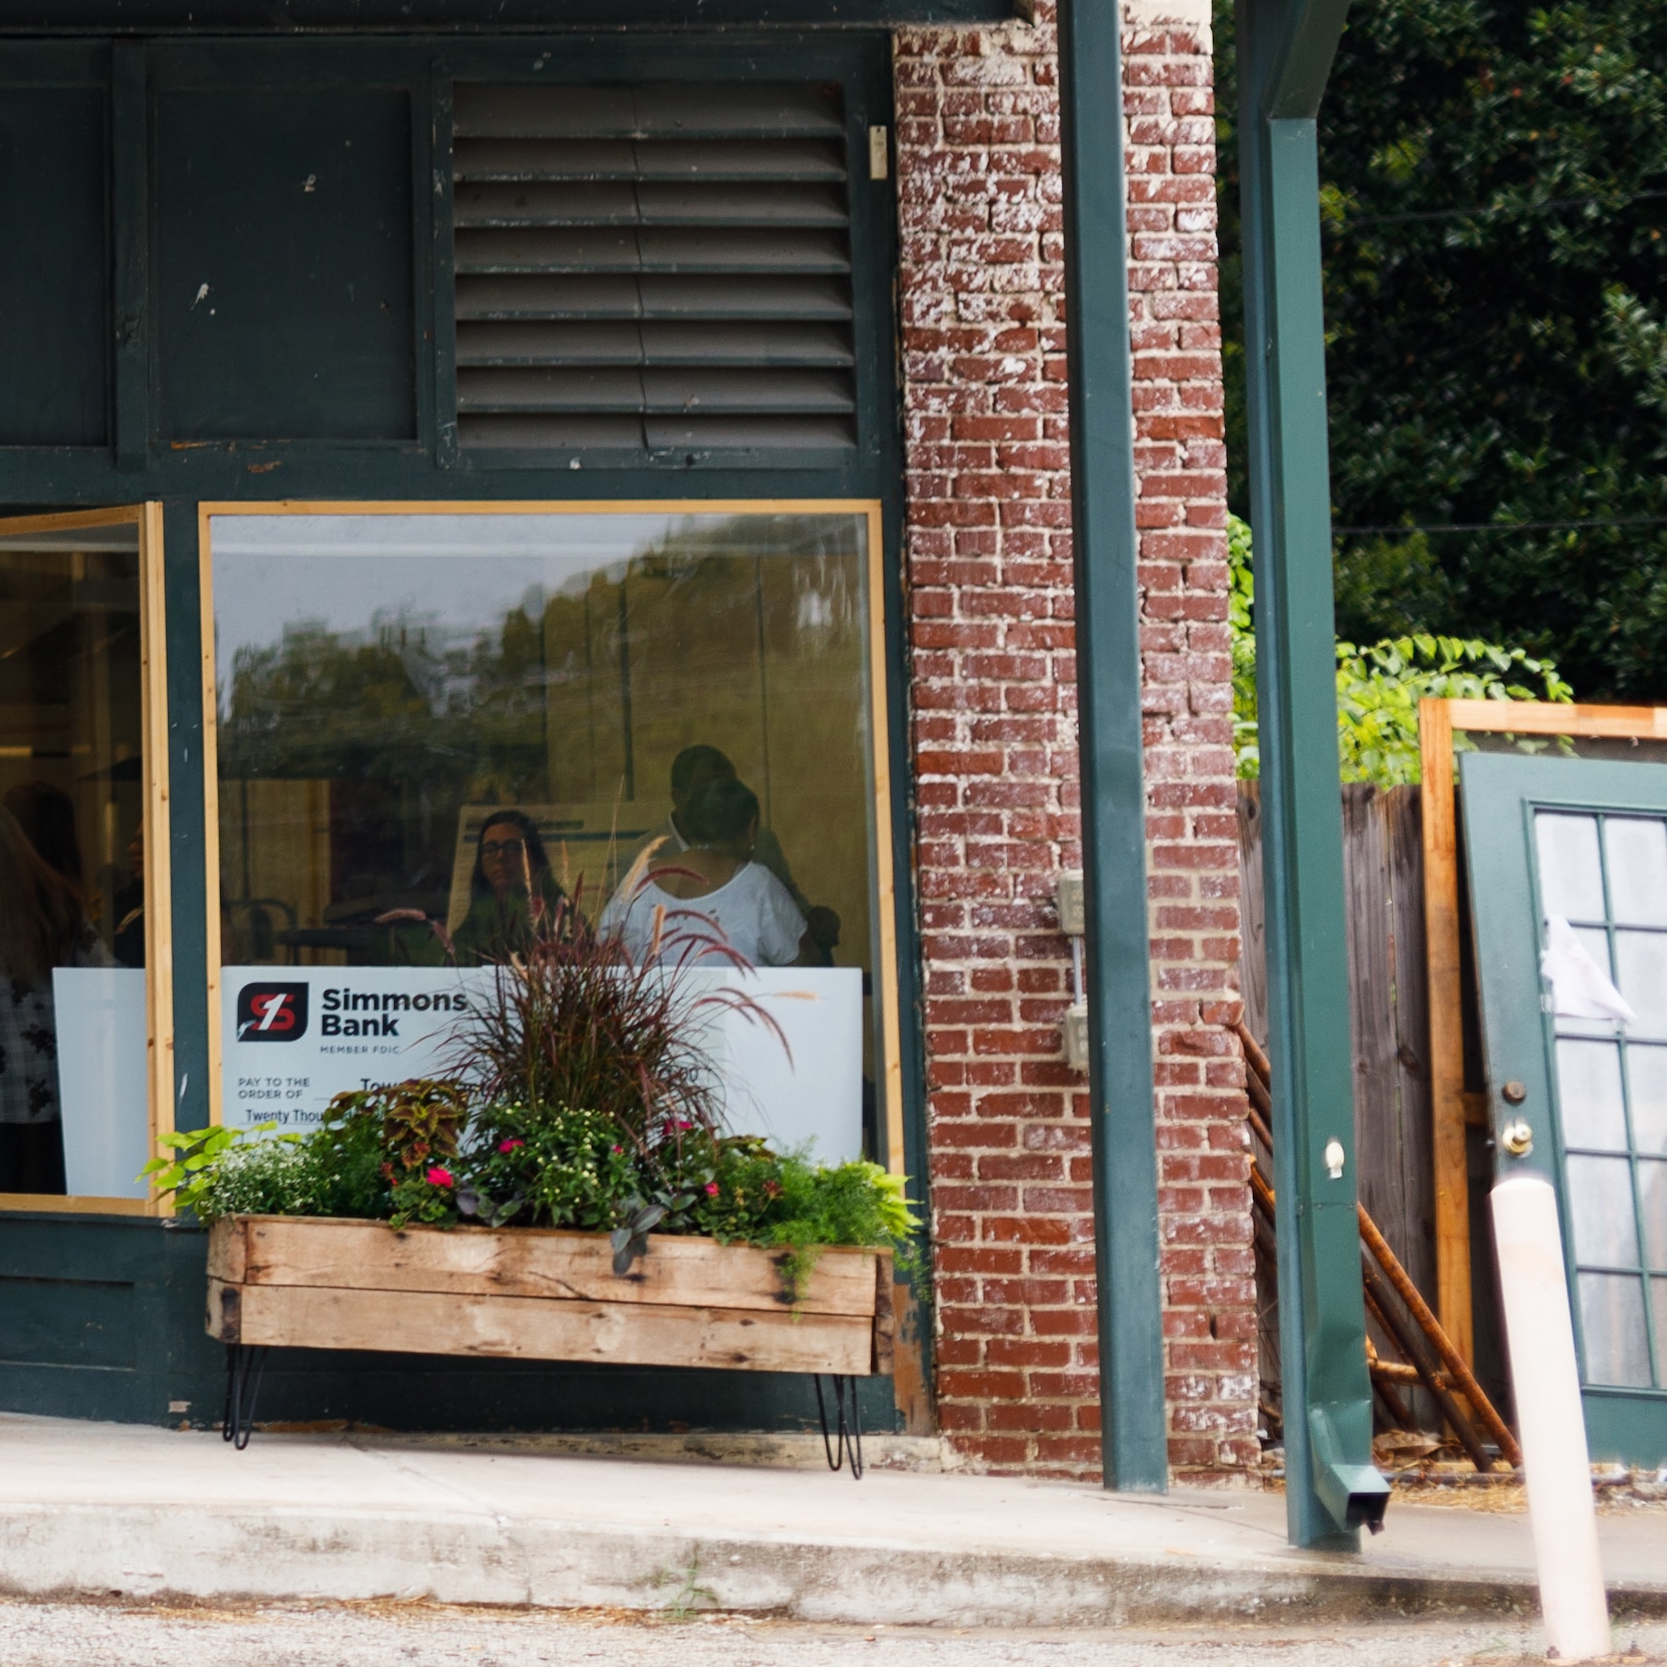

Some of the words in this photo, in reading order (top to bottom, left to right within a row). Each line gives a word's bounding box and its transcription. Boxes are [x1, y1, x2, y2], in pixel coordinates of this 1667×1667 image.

[321, 988, 468, 1012] Simmons
[321, 1013, 400, 1037] Bank
[319, 1045, 369, 1055] MEMBER
[372, 1045, 401, 1055] FDIC
[238, 1077, 261, 1087] PAY
[265, 1077, 282, 1087] TO
[286, 1077, 311, 1087] THE
[238, 1089, 282, 1099] ORDER
[285, 1089, 303, 1099] OF
[245, 1109, 290, 1124] Twenty
